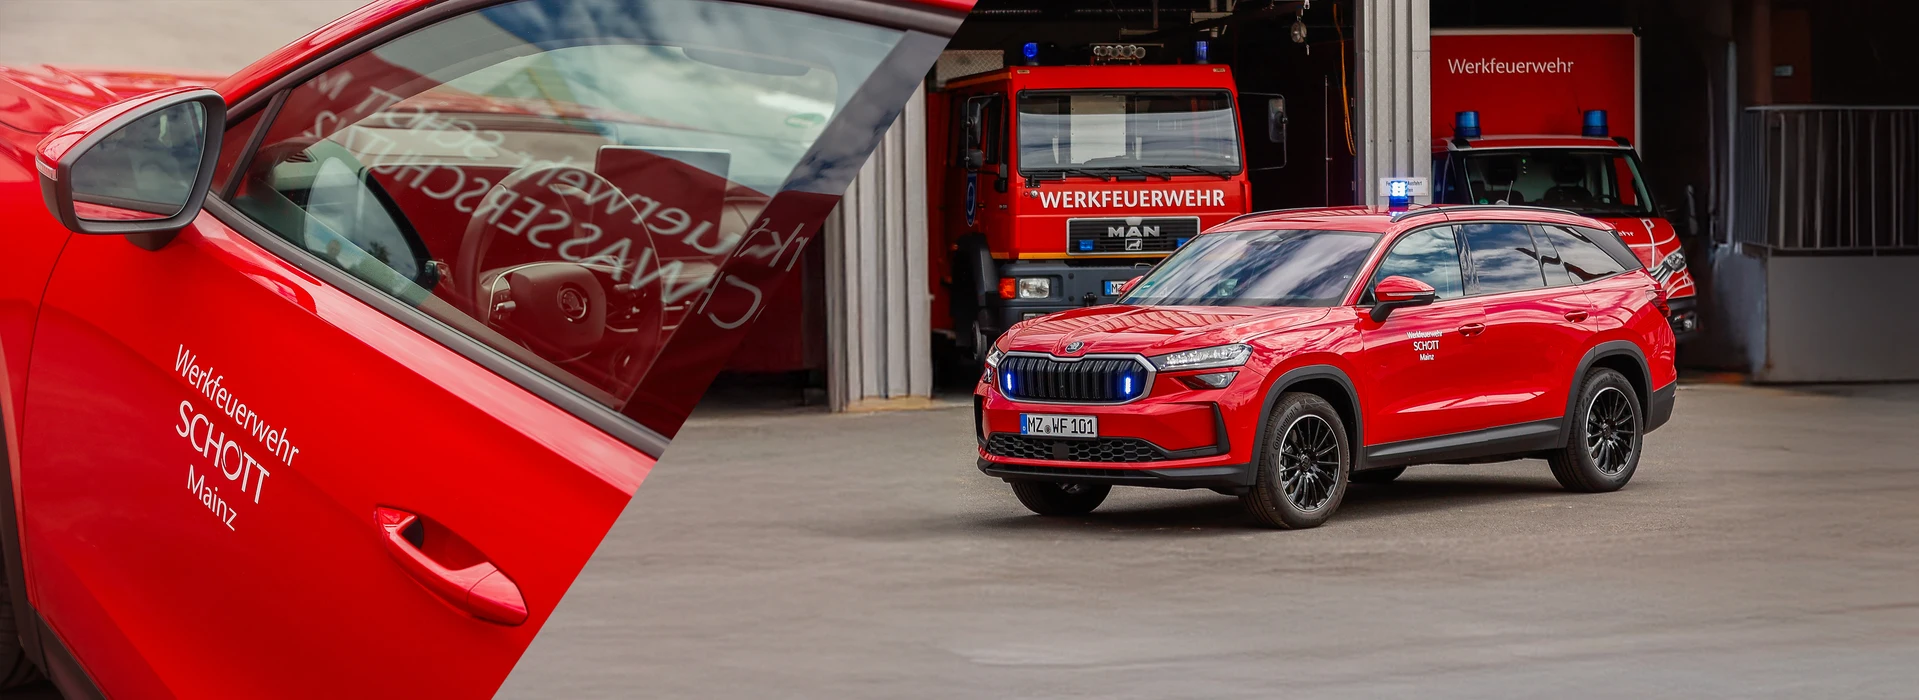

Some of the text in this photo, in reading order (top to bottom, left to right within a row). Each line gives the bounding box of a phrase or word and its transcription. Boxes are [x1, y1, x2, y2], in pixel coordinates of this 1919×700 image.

[1447, 57, 1574, 74] Werkfeuerwehr
[1039, 189, 1226, 209] WERKFEUERWEHR
[1107, 225, 1160, 238] MAN
[1406, 330, 1443, 339] Werkfeuerwehr
[1413, 340, 1440, 351] SCHOTT
[1419, 352, 1435, 361] Mainz
[175, 344, 299, 467] Werkfeuerwehr
[1028, 417, 1095, 434] MZ WF 101
[175, 400, 270, 504] SCHOTT
[187, 464, 237, 531] Mainz
